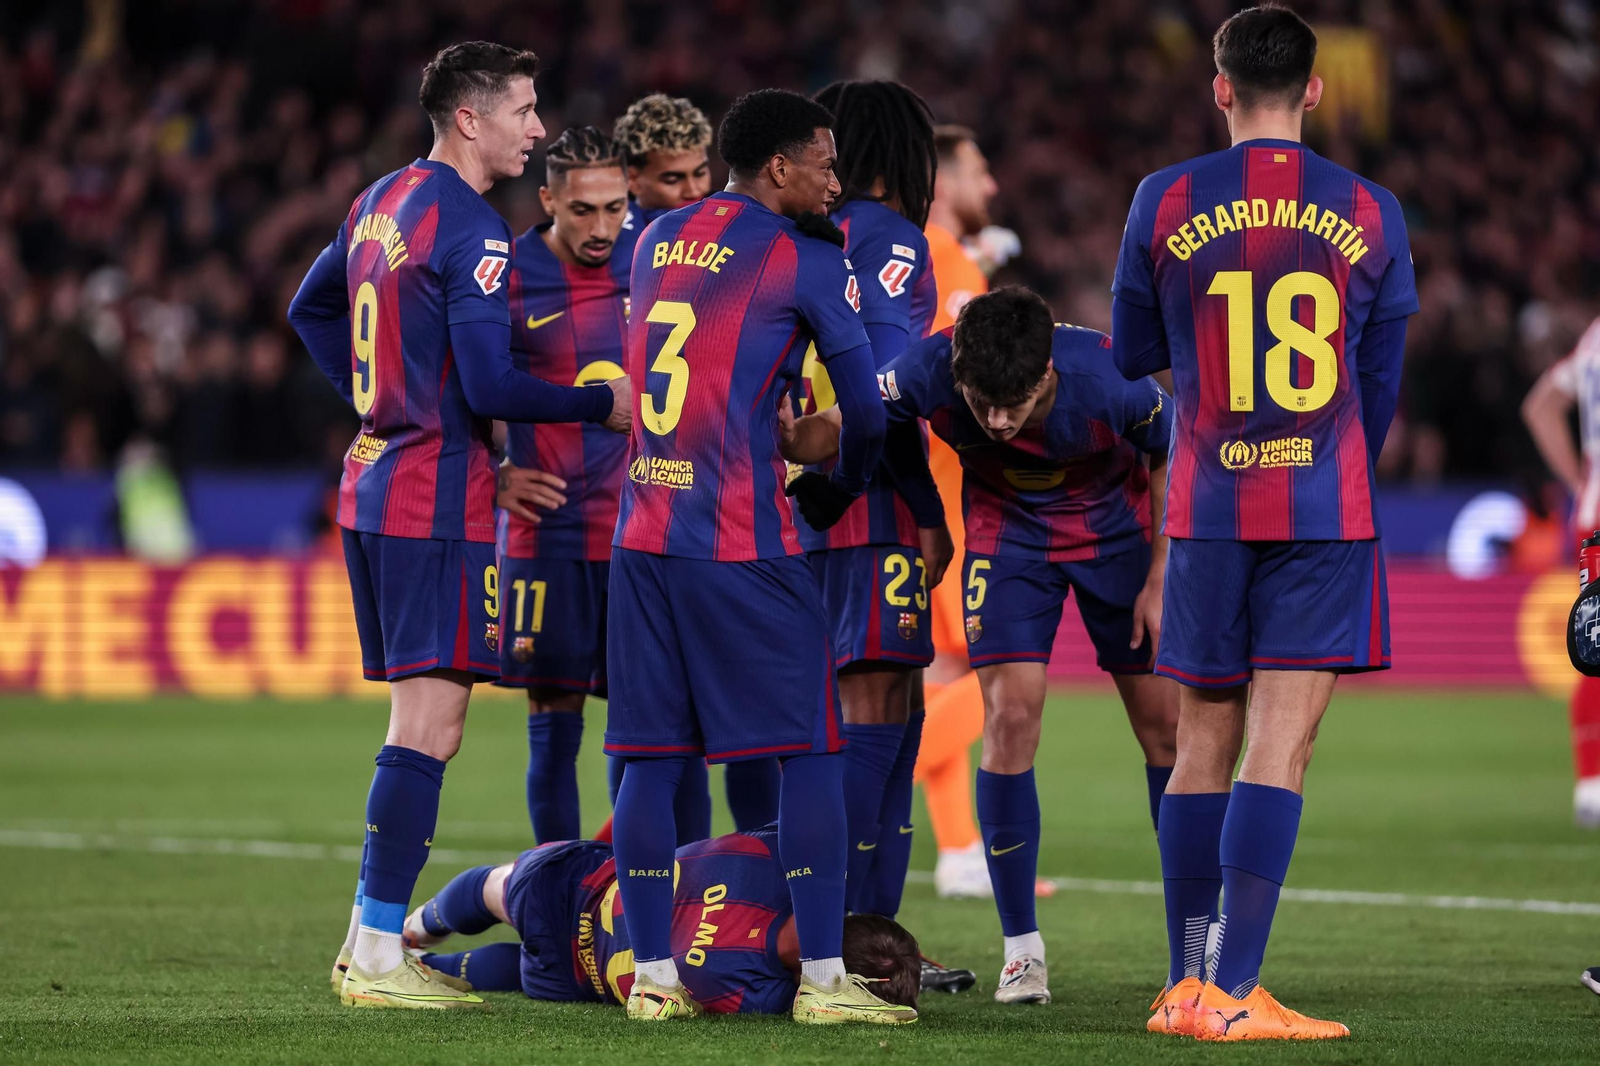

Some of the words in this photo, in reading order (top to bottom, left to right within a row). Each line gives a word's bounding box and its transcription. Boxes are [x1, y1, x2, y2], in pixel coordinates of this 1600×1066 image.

[653, 240, 735, 273] BALDE
[1166, 198, 1269, 261] GERARD
[1273, 198, 1369, 265] MARTÍN
[353, 282, 378, 415] 9
[1206, 271, 1340, 412] 18
[641, 300, 697, 436] 3
[650, 457, 694, 473] UNHCR
[1259, 449, 1313, 464] ACNUR
[1260, 437, 1313, 453] UNHCR
[650, 468, 694, 484] ACNUR
[484, 565, 500, 618] 9
[512, 579, 547, 633] 11
[884, 553, 928, 610] 23
[965, 559, 992, 611] 5
[629, 869, 670, 878] BARÇA
[785, 867, 813, 880] ARÇA
[685, 883, 728, 967] OLMO
